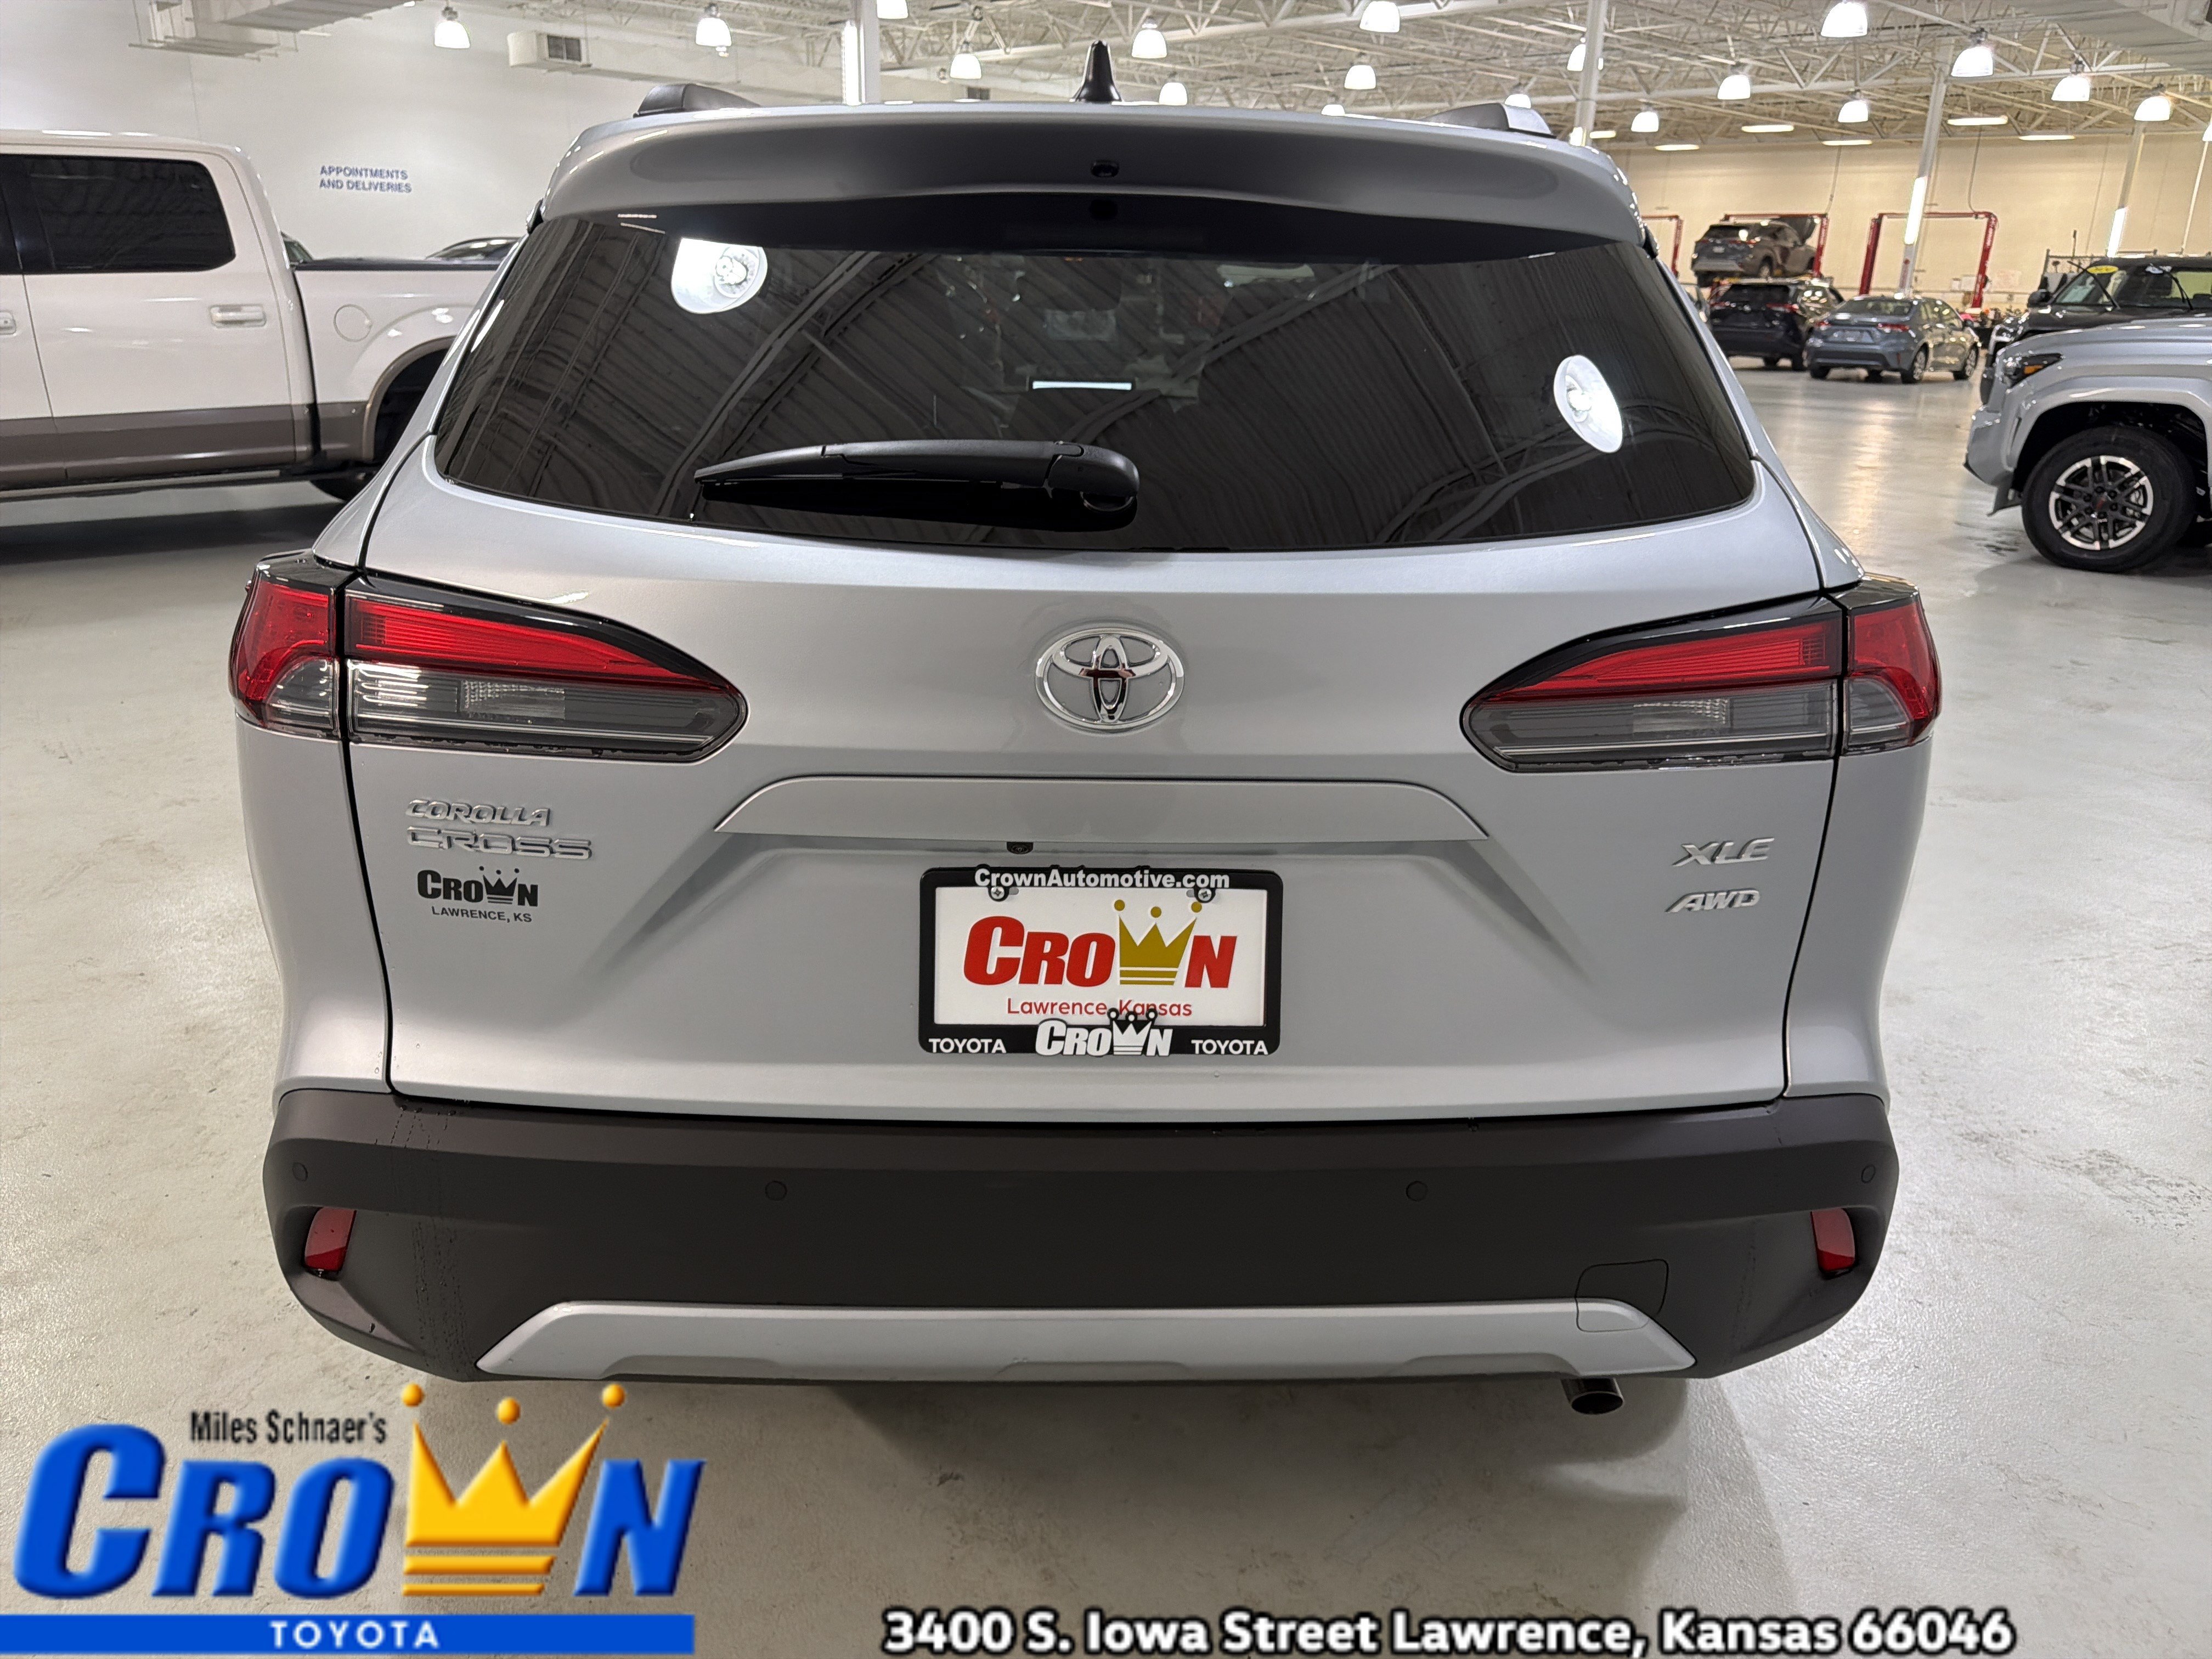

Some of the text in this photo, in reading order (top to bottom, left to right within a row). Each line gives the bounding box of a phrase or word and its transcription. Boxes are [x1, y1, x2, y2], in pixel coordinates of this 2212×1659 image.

[319, 165, 408, 180] APPOINTMENTS
[319, 178, 412, 193] AND DELIVERIES
[405, 798, 551, 827] COROLLA
[407, 826, 592, 860] CROSS
[1672, 836, 1775, 867] XLE
[974, 868, 1230, 889] CrownAutomotive.com
[1664, 887, 1760, 913] AWD
[431, 906, 533, 923] LAWRENCE, KS
[929, 1037, 1007, 1054] TOYOTA
[1191, 1039, 1268, 1056] TOYOTA
